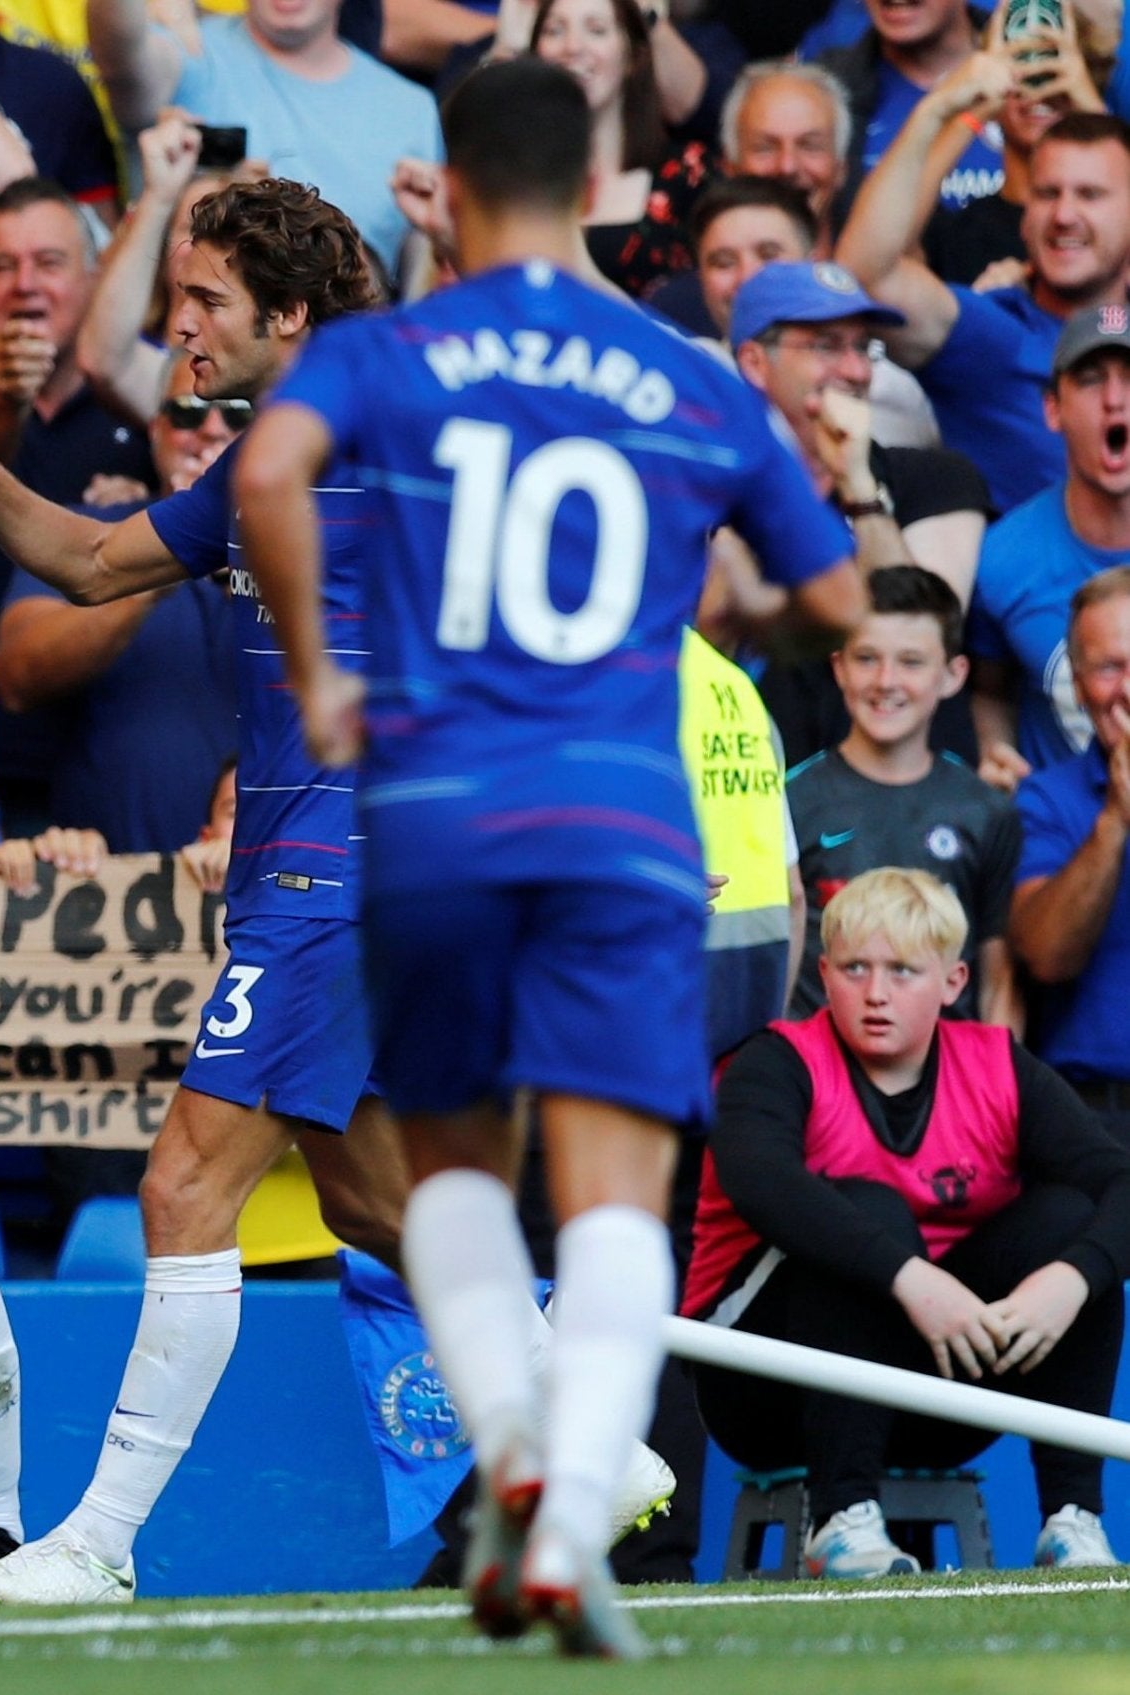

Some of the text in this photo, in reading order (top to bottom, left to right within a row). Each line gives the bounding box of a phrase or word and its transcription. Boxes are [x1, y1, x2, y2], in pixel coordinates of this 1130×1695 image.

[423, 327, 676, 425] HAZARD
[432, 415, 650, 666] 10
[206, 965, 264, 1038] 3
[142, 1039, 189, 1080] I
[107, 1433, 135, 1452] CFC
